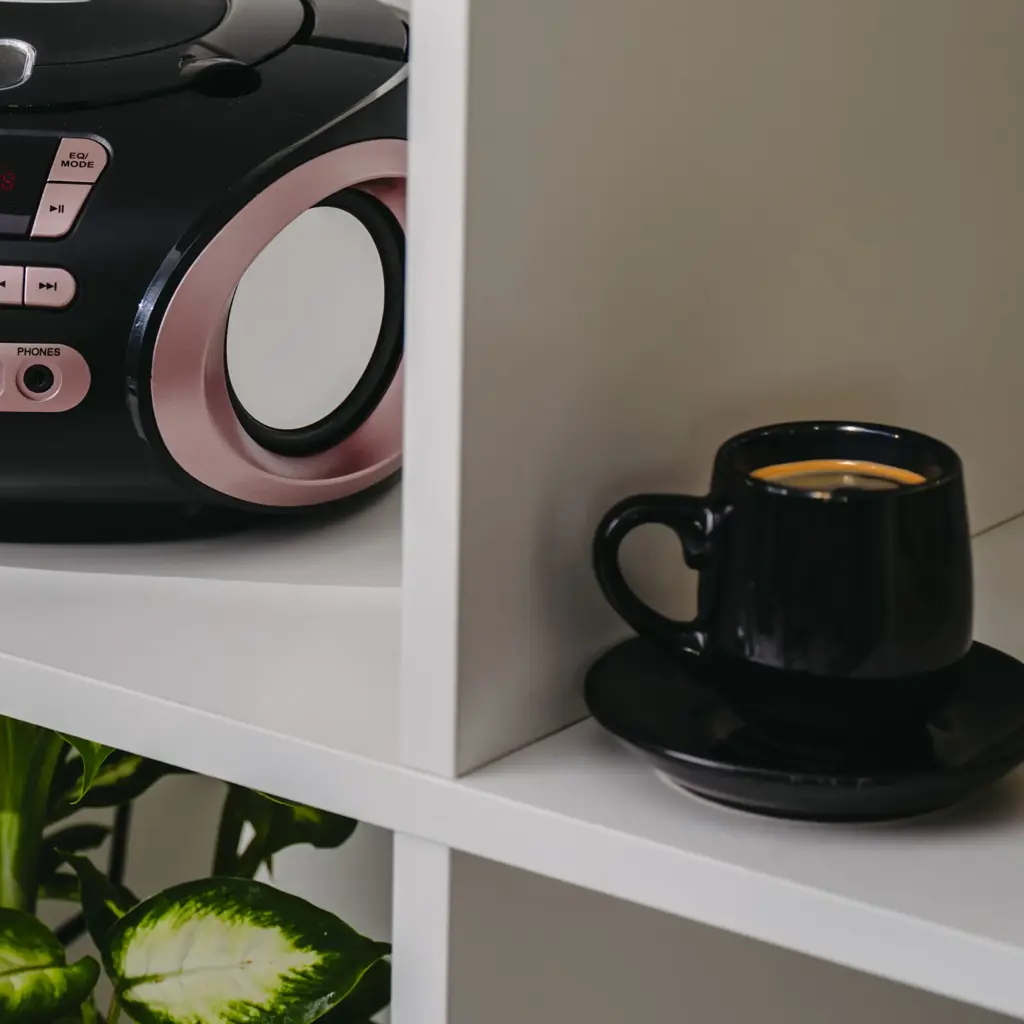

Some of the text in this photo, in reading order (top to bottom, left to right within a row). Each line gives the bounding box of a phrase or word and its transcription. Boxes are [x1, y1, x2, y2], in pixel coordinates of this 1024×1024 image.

[69, 152, 89, 160] EQ/
[61, 160, 94, 168] MODE
[17, 348, 61, 357] PHONES
